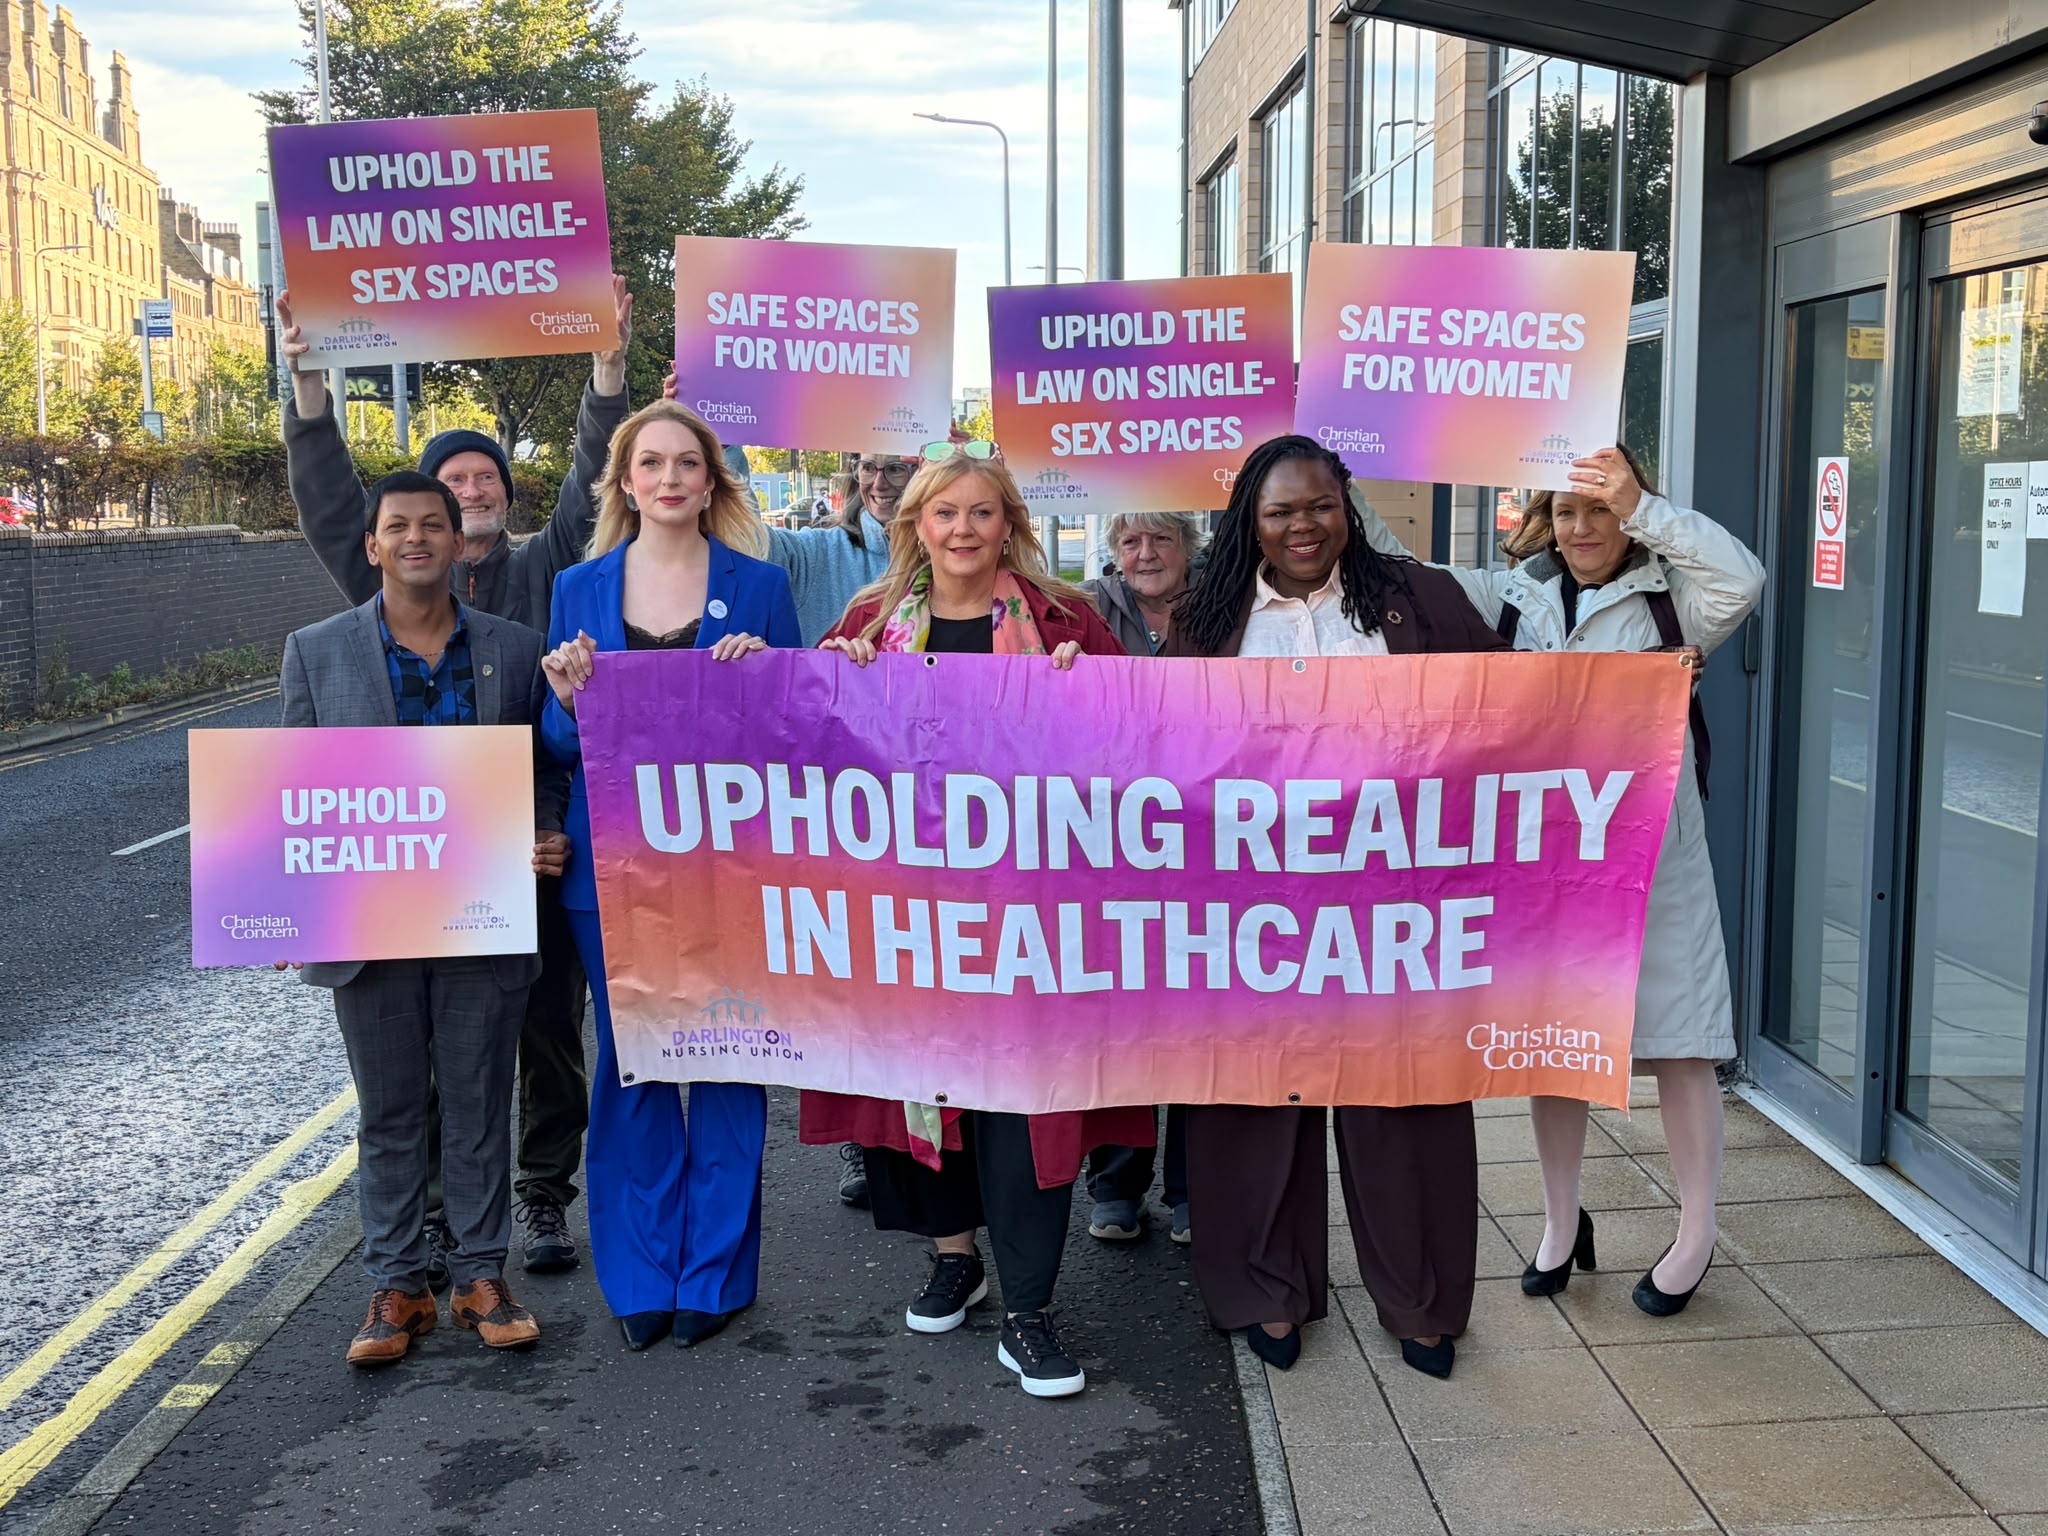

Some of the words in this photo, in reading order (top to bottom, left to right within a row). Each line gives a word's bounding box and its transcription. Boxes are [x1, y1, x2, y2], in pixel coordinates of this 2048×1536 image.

[329, 149, 477, 193] UPHOLD
[482, 145, 553, 183] THE
[306, 211, 383, 251] LAW
[391, 208, 444, 245] ON
[450, 200, 588, 242] SINGLE-
[350, 266, 420, 304] SEX
[425, 258, 559, 299] SPACES
[530, 310, 592, 326] Christian
[707, 291, 788, 328] SAFE
[795, 296, 920, 335] SPACES
[324, 333, 390, 344] DARLINGTON
[540, 322, 600, 336] Concern
[1041, 311, 1175, 350] UPHOLD
[1182, 307, 1247, 343] THE
[1338, 304, 1432, 345] SAFE
[1438, 308, 1586, 352] SPACES
[319, 343, 361, 351] NURSING
[715, 335, 777, 370] FOR
[784, 339, 910, 378] WOMEN
[1016, 369, 1085, 405] LAW
[1092, 367, 1139, 401] ON
[1147, 361, 1276, 399] SINGLE-
[1342, 353, 1415, 393] FOR
[1424, 356, 1572, 400] WOMEN
[697, 400, 751, 415] Christian
[705, 410, 757, 425] Concern
[1051, 421, 1113, 457] SEX
[1119, 416, 1243, 454] SPACES
[1318, 426, 1380, 443] Christian
[1326, 438, 1385, 454] Concern
[1022, 485, 1082, 494] DARLINGTON
[1989, 478, 2004, 487] OFFICE
[2005, 477, 2022, 487] HOURS
[2001, 520, 2012, 530] 5pm
[1986, 540, 1999, 549] ONLY
[281, 786, 447, 826] UPHOLD
[635, 763, 1184, 872] UPHOLDING
[1215, 769, 1635, 874] REALITY
[284, 833, 448, 874] REALITY
[221, 914, 291, 930] Christian
[231, 926, 299, 940] Concern
[761, 885, 852, 979] IN
[871, 895, 1494, 996] HEALTHCARE
[672, 1026, 792, 1047] DARLINGTON
[1466, 1021, 1600, 1050] Christian
[662, 1044, 740, 1058] NURSING
[750, 1047, 803, 1062] UNION
[1483, 1044, 1613, 1076] Concern
